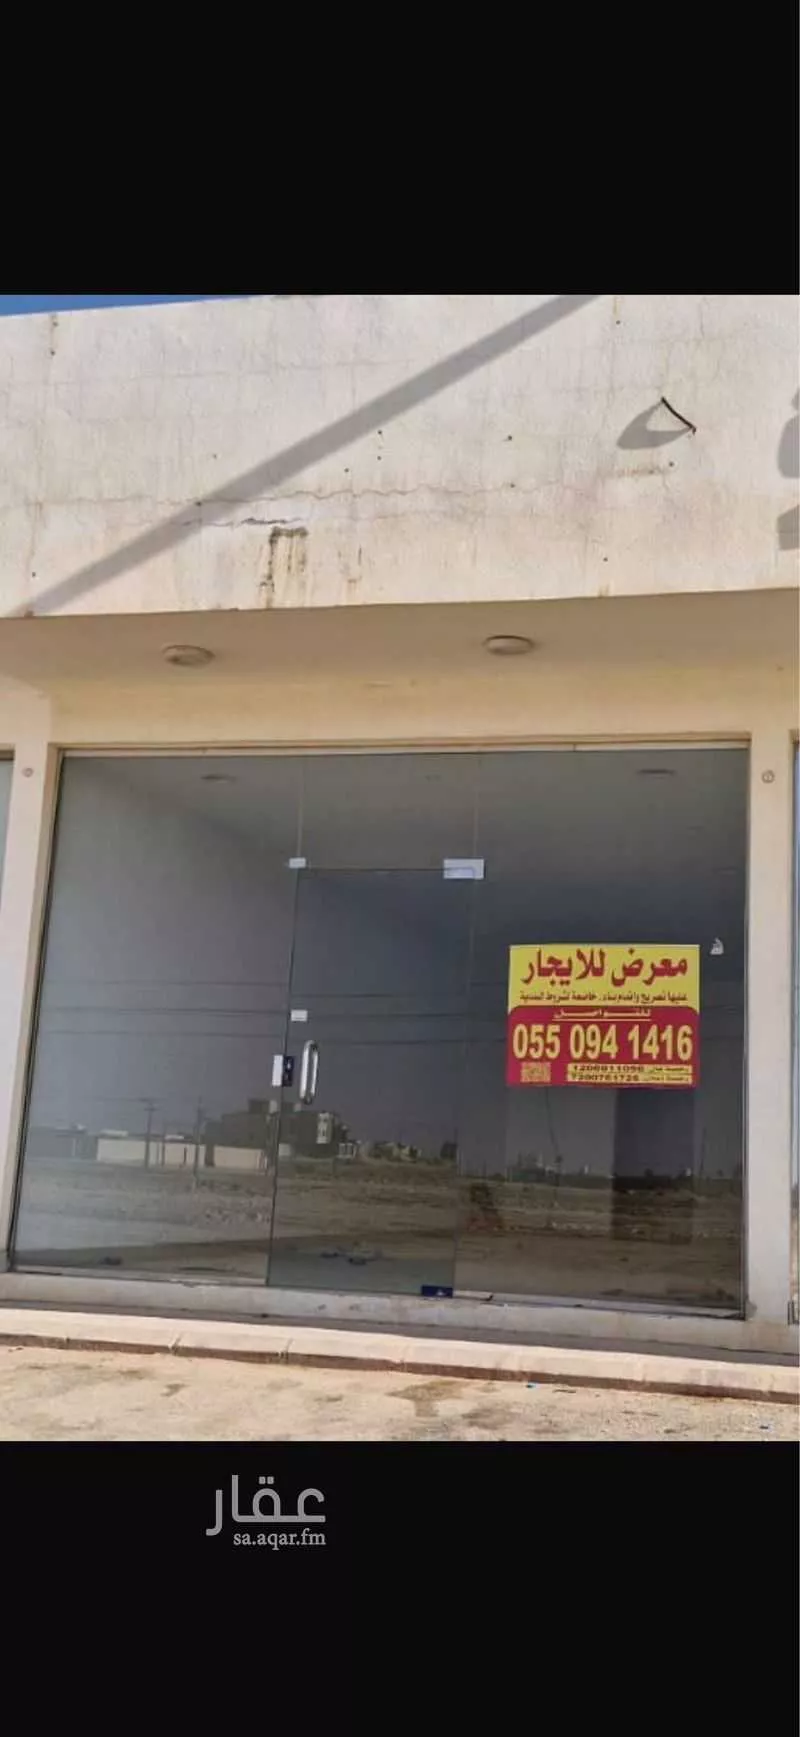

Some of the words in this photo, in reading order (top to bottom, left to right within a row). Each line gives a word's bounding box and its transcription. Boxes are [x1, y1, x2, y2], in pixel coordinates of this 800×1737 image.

[521, 948, 606, 986] للايجار
[611, 948, 688, 987] معرض
[512, 1023, 561, 1060] 055
[569, 1023, 619, 1060] 094
[627, 1023, 693, 1062] 1416
